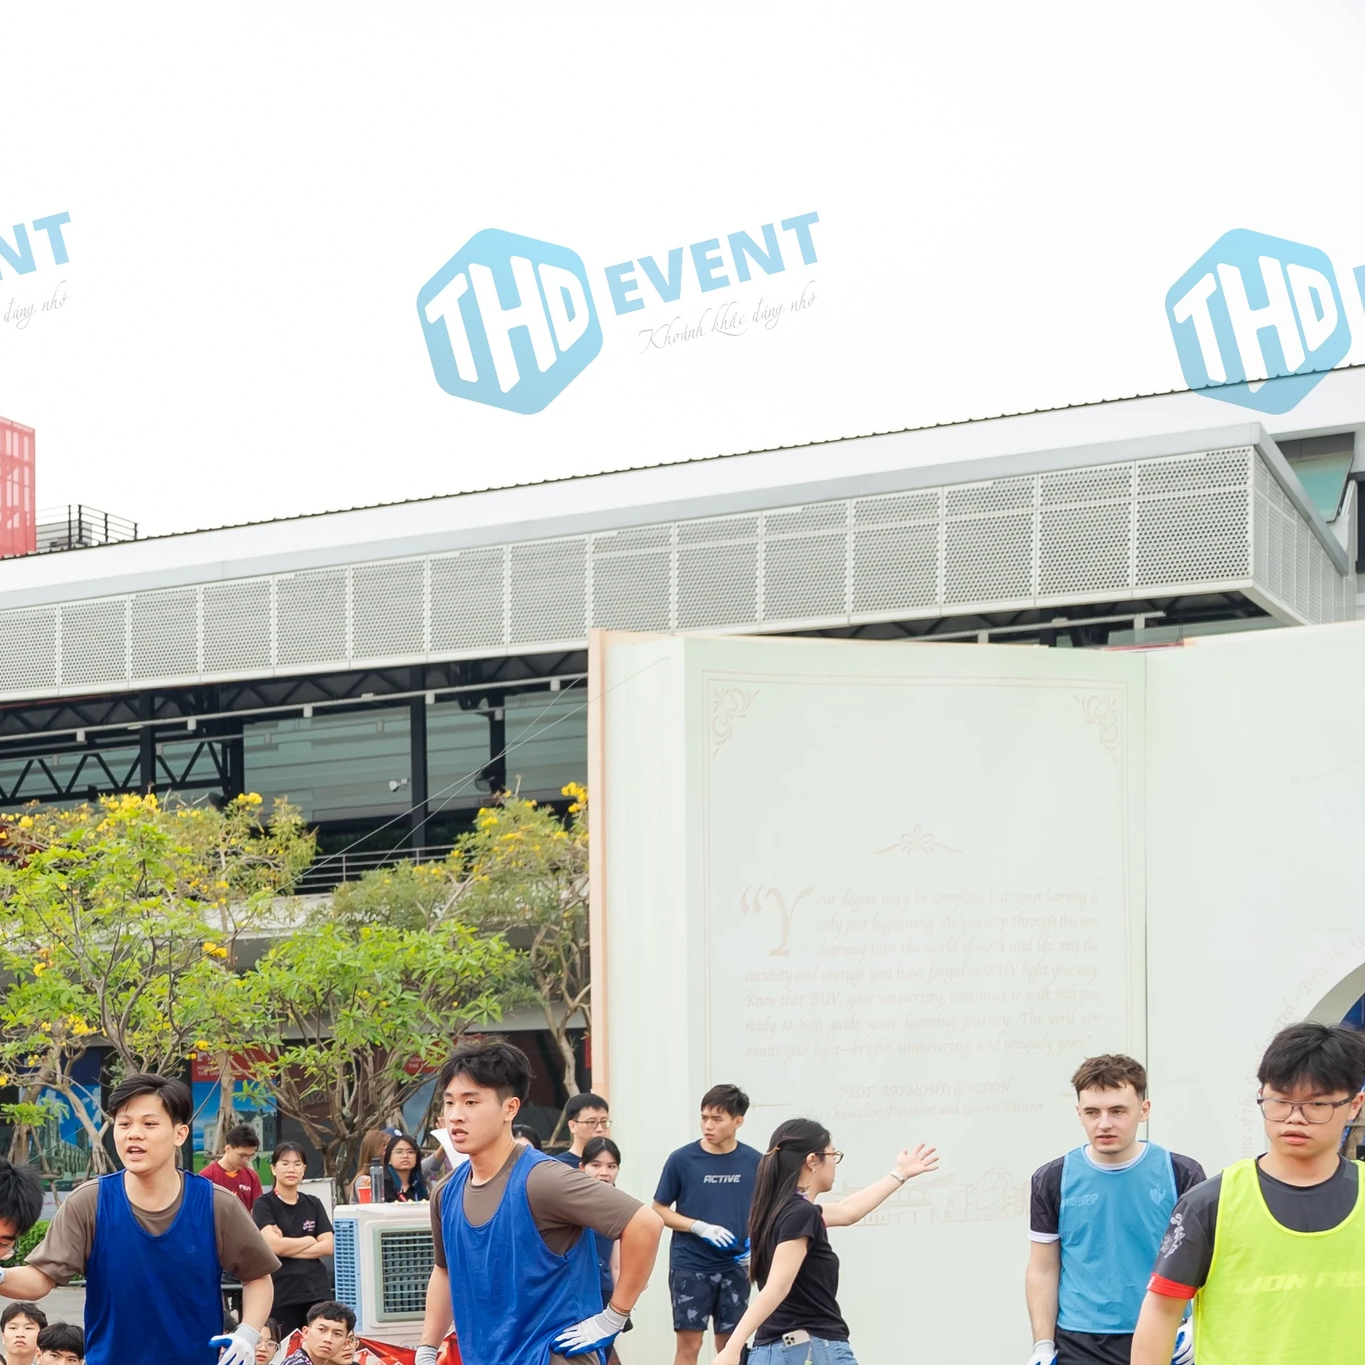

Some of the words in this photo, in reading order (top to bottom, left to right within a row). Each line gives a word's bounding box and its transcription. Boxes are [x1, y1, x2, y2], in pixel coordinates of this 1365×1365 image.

[1014, 892, 1043, 911] your
[1046, 885, 1087, 910] learning
[1012, 909, 1057, 934] through
[817, 938, 867, 962] doorway
[1009, 933, 1035, 952] and
[1058, 940, 1081, 958] may
[1083, 933, 1100, 952] the
[744, 967, 793, 989] curiosity
[795, 963, 820, 981] and
[821, 968, 866, 988] courage
[1022, 959, 1048, 984] light
[780, 989, 804, 1007] that
[846, 993, 875, 1012] your
[1026, 984, 1051, 1000] walk
[745, 1014, 776, 1040] ready
[782, 1019, 794, 1031] to
[829, 1012, 860, 1036] guide
[866, 1018, 898, 1037] your
[905, 1011, 957, 1034] learning
[1019, 1008, 1042, 1025] The
[782, 1045, 811, 1064] your
[1004, 1032, 1053, 1057] uniquely
[879, 1080, 950, 1098] RAYMOND
[953, 1077, 1014, 1096] GORDON
[1002, 1100, 1047, 1114] Director
[702, 1174, 742, 1184] ACTIVE
